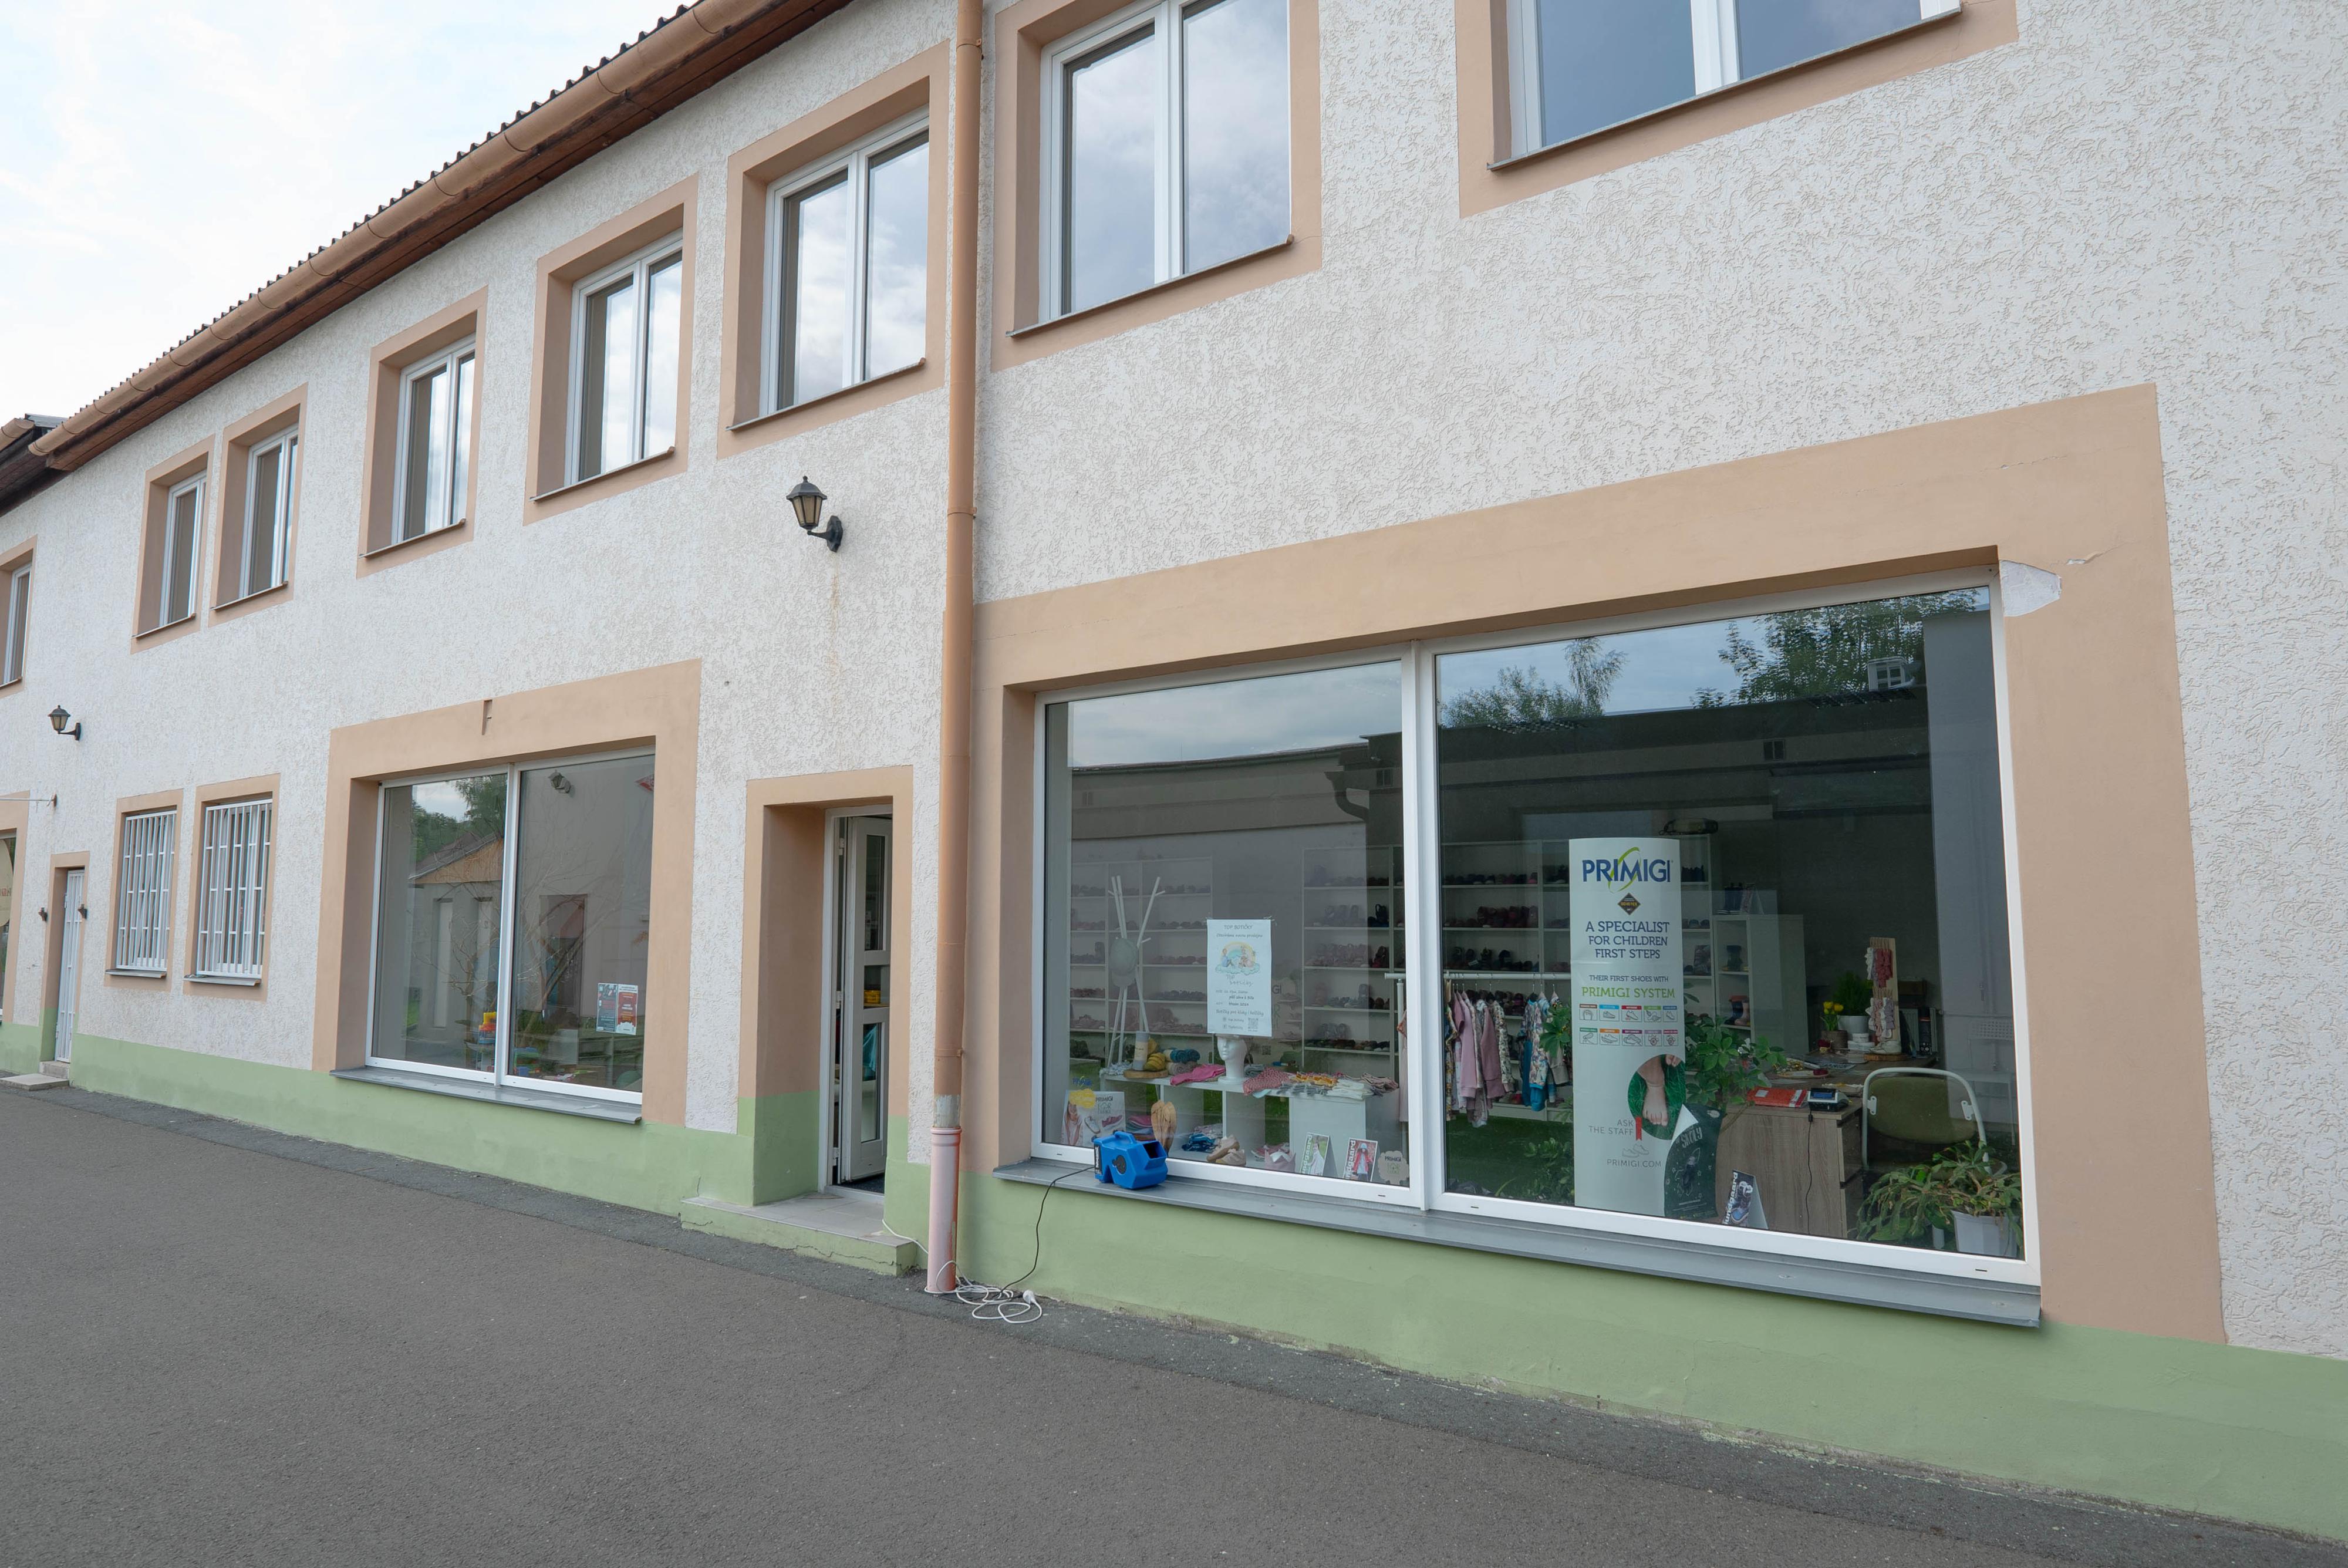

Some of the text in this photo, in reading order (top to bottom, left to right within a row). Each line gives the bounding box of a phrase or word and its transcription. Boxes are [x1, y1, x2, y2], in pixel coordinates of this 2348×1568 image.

[1582, 859, 1671, 882] PRIMIGI
[1585, 920, 1669, 933] A SPECIALIST
[1589, 936, 1668, 946] FOR CHILDREN
[1595, 949, 1660, 959] FIRST STEPS
[1581, 987, 1675, 998] PRIMIGI SYSTEM
[1608, 1127, 1634, 1135] STAFF
[1606, 1159, 1662, 1168] PRIMIGI.COM
